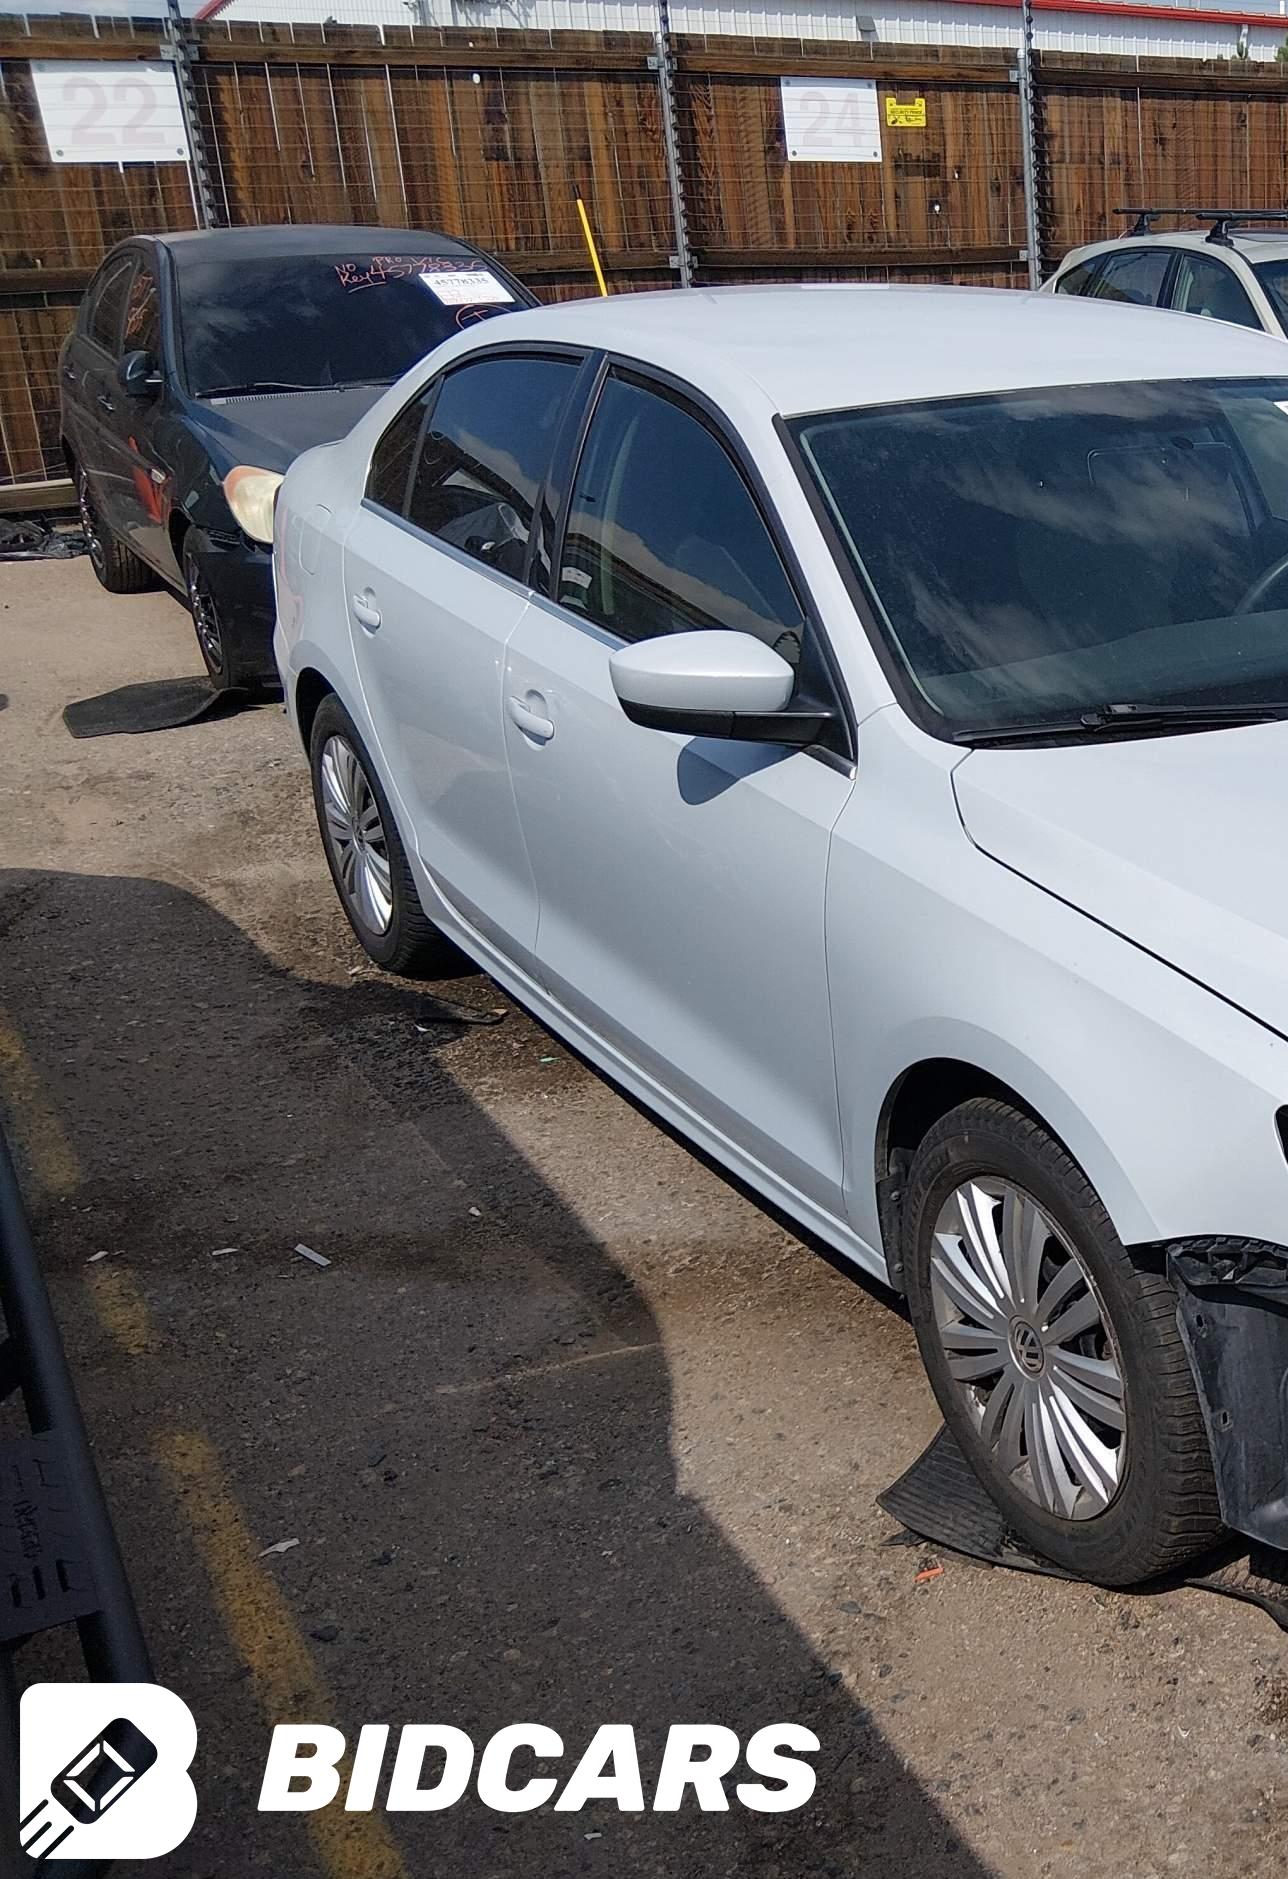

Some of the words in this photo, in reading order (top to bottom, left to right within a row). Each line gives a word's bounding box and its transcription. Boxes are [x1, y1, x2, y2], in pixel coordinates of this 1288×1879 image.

[62, 77, 166, 145] 22
[799, 91, 864, 147] 24
[335, 263, 356, 275] NO
